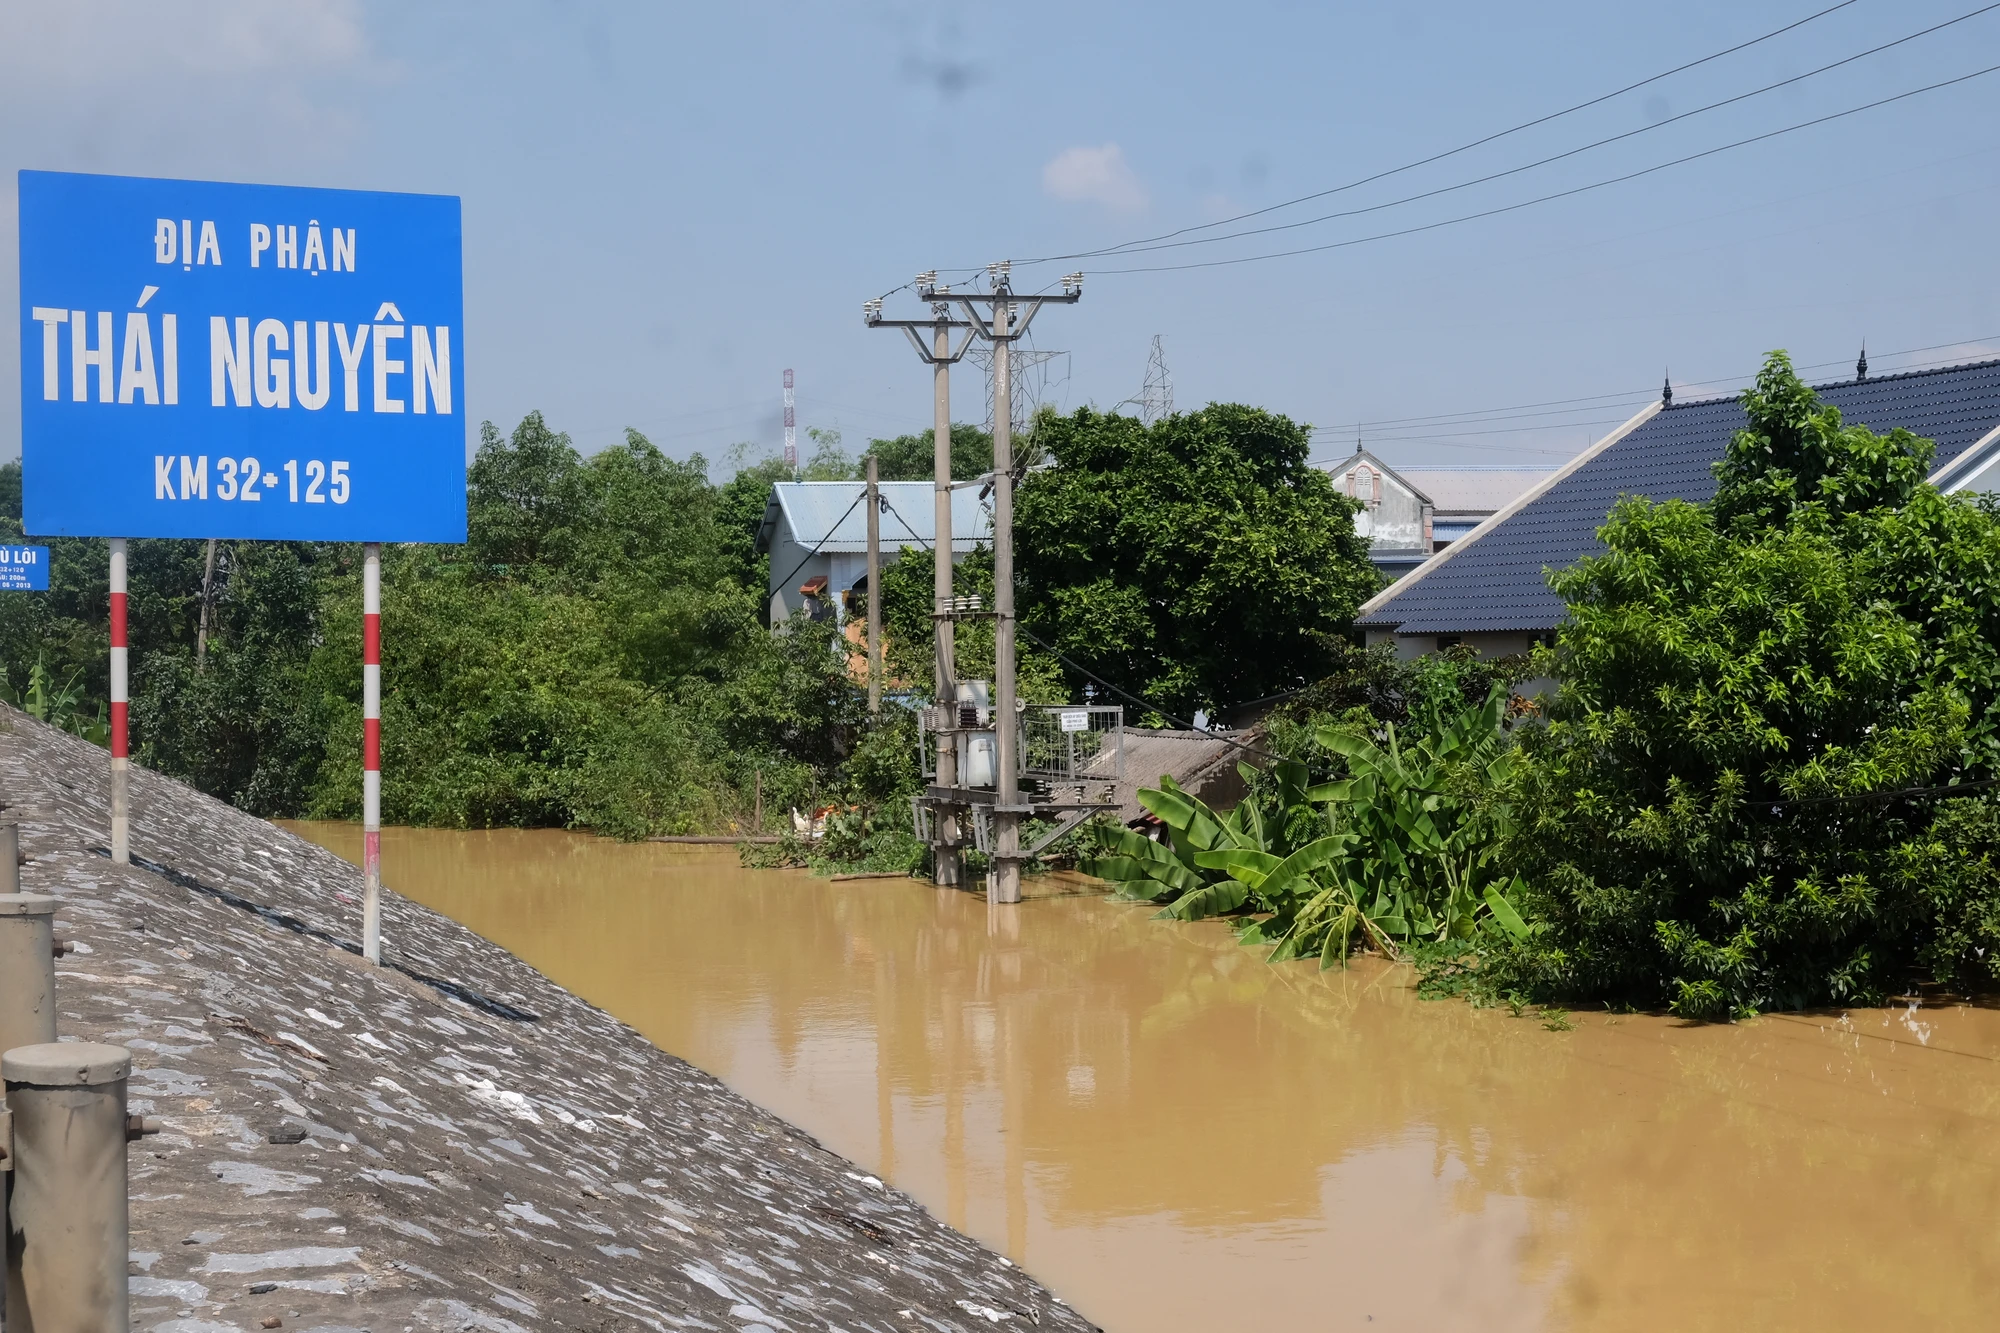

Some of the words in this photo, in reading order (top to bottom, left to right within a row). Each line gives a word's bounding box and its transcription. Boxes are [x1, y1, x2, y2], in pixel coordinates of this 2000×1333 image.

[154, 218, 222, 272] ĐỊA
[250, 219, 356, 277] PHẬN
[32, 285, 179, 405] THÁI
[210, 301, 453, 415] NGUYÊN
[154, 455, 208, 500] KM
[216, 456, 351, 505] 32+125
[14, 547, 36, 564] LÔI
